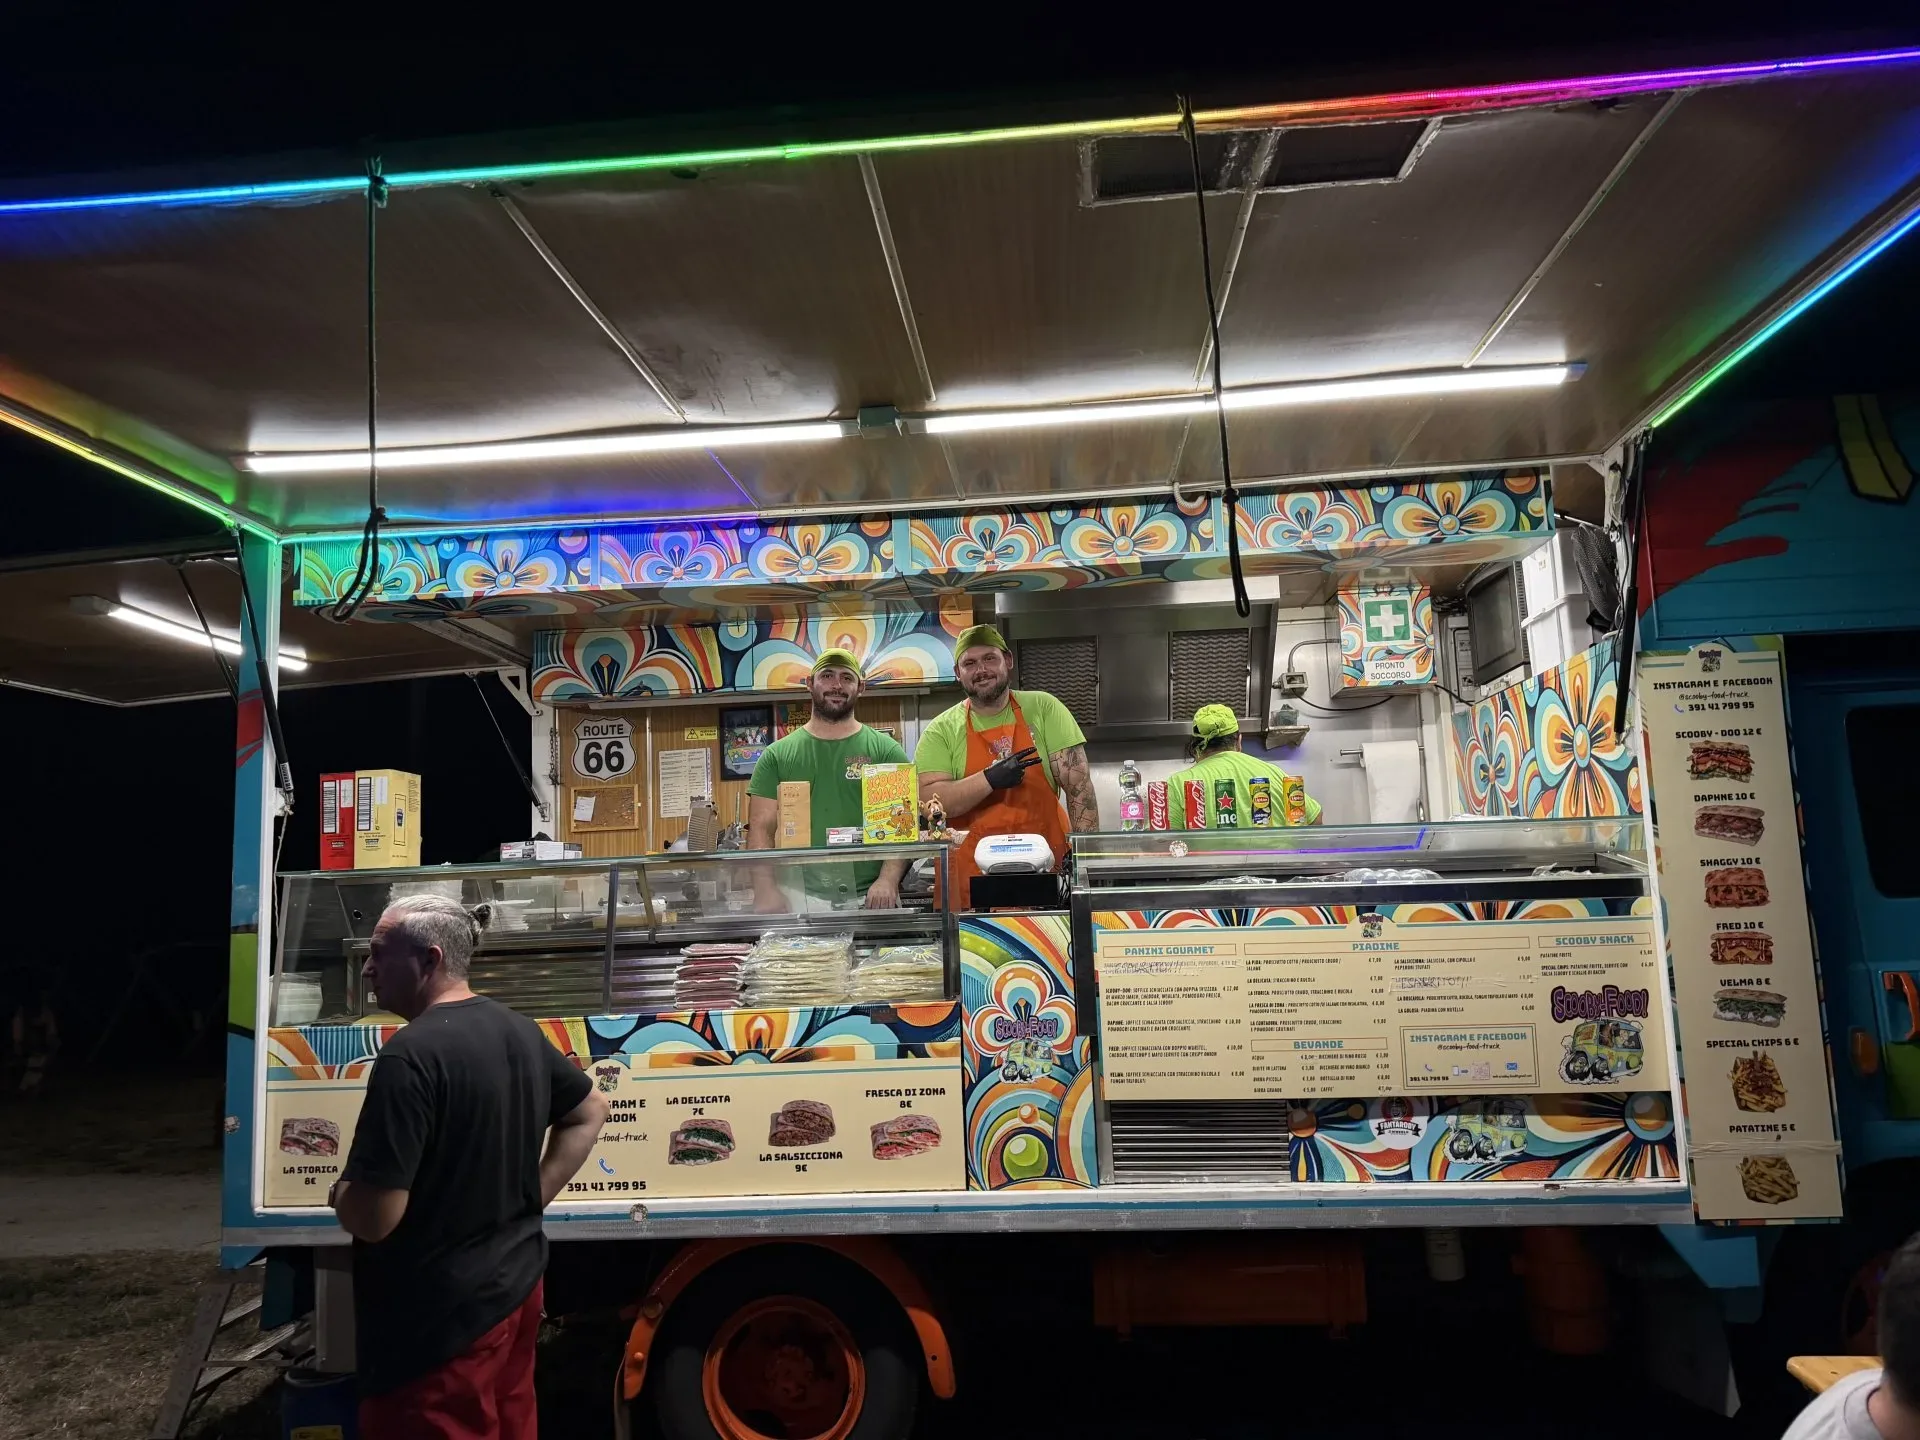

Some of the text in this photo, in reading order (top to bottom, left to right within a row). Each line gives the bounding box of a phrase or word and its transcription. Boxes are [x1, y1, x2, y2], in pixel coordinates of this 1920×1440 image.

[1370, 671, 1411, 680] SOCCORSO
[1653, 677, 1773, 690] INSTAGRAM E FACEBOOK
[1679, 690, 1749, 701] @scooby-food-truck
[1689, 701, 1754, 712] 391 41 799 95
[583, 724, 624, 736] ROUTE
[1675, 729, 1713, 738] SCOOBY
[1721, 729, 1741, 737] DOO
[1743, 728, 1754, 736] 12
[584, 740, 625, 773] 66
[867, 768, 910, 790] SCOOBY
[868, 784, 911, 805] SNACKS
[1694, 792, 1756, 803] DAPHNE 10 €
[1216, 811, 1237, 825] ine
[1700, 857, 1761, 867] SHAGGY 10 €
[1716, 922, 1742, 931] FRED
[1744, 921, 1756, 929] 10
[1555, 935, 1634, 945] SCOOBY SNACK
[1125, 946, 1214, 956] PANINI GOURMET
[1352, 942, 1399, 951] PIADINE
[1720, 977, 1771, 987] VELMA 8 €
[1410, 1034, 1467, 1042] INSTAGRAM
[1477, 1032, 1527, 1040] FACEBOOK
[1293, 1040, 1343, 1049] BEVANDE
[1706, 1038, 1799, 1049] SPECIAL CHIPS 6 €
[865, 1087, 946, 1098] FRESCA DI ZONA
[640, 1099, 646, 1108] E
[666, 1095, 731, 1105] LA DELICATA
[606, 1113, 636, 1123] BOOK
[1729, 1124, 1779, 1133] PATATINE
[597, 1133, 648, 1144] -food-truck
[759, 1151, 843, 1162] LA SALSICCIONA
[297, 1166, 338, 1174] STORICA
[795, 1164, 807, 1172] 9€
[304, 1177, 316, 1185] 8€
[567, 1181, 646, 1192] 391 41 799 95
